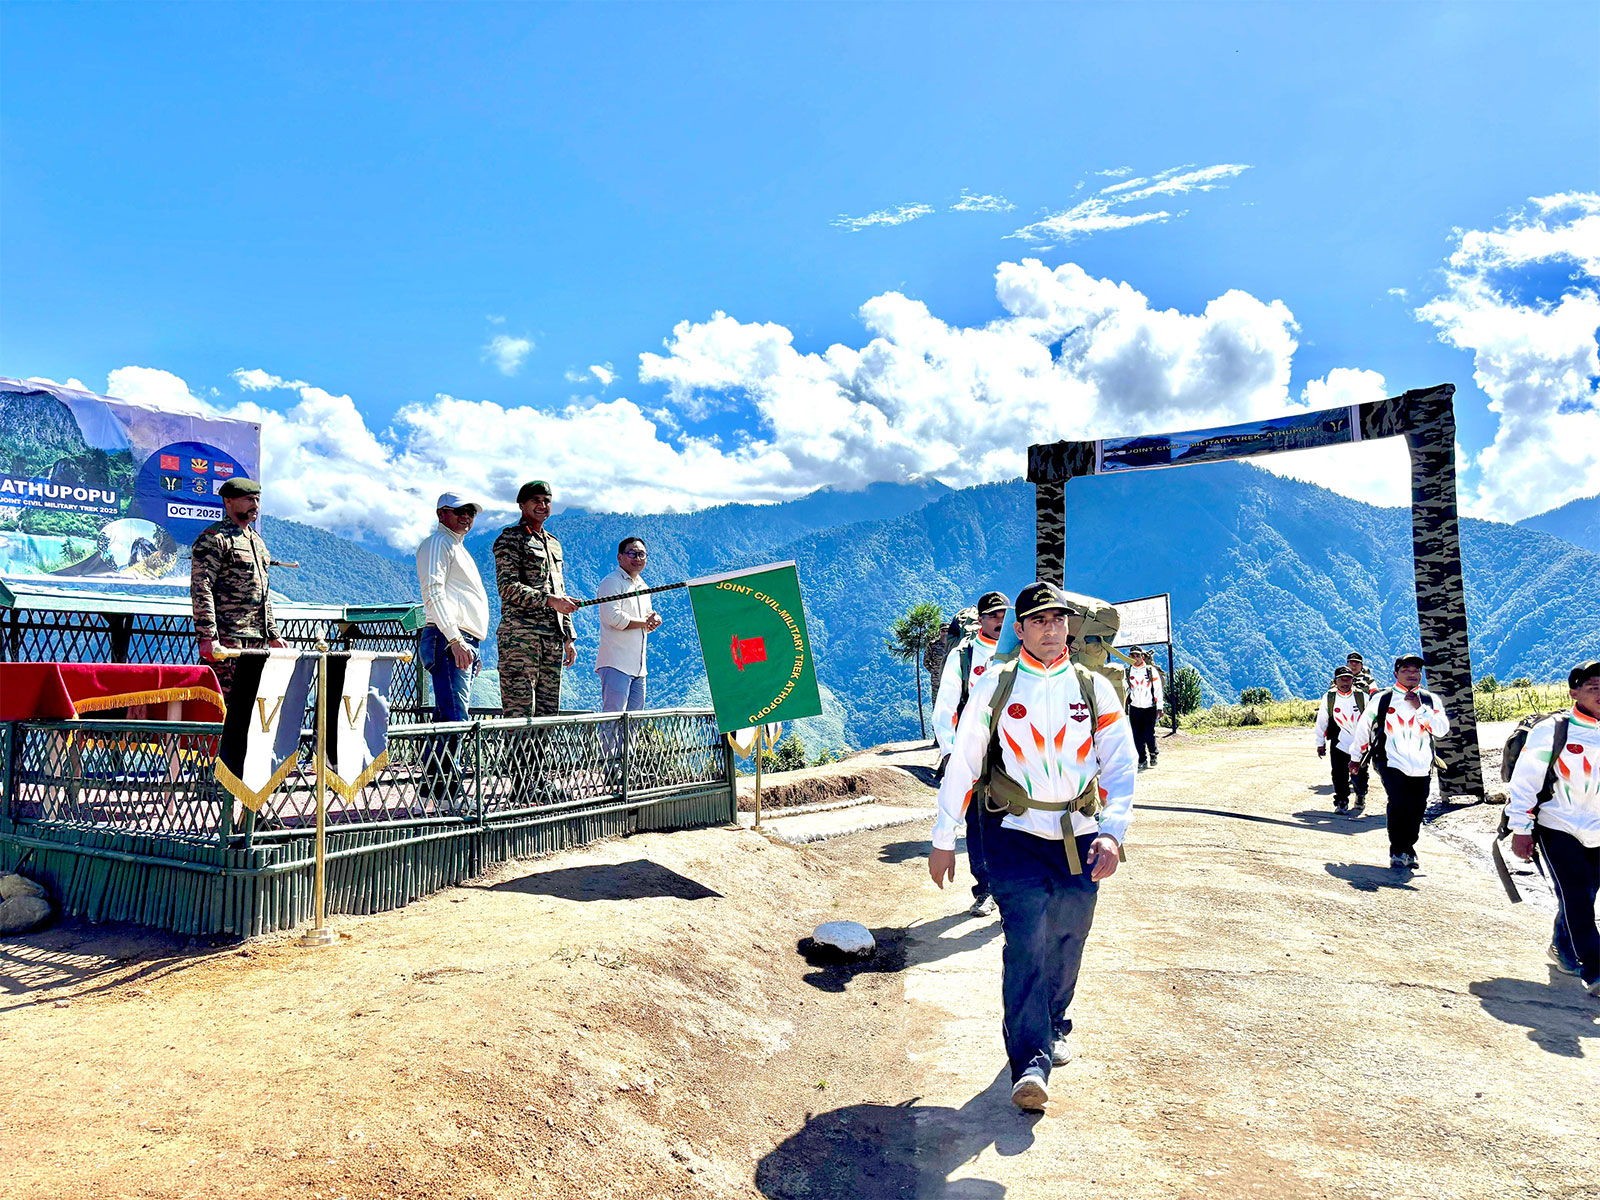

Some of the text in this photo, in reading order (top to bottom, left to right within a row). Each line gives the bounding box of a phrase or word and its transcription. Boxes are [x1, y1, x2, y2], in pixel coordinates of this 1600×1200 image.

[1129, 446, 1154, 454] JOINT
[1156, 443, 1180, 452] CIVIL
[1189, 438, 1232, 449] MILITARY
[1266, 425, 1320, 438] ATHUPOPU
[0, 479, 116, 504] ATHUPOPU
[23, 499, 44, 507] CIVIL
[44, 501, 79, 510] MILITARY
[80, 505, 99, 513] TREK
[100, 506, 118, 515] 2025
[169, 506, 221, 519] OCT 2025
[716, 581, 754, 595] JOINT
[790, 653, 804, 680] TREK
[256, 696, 286, 733] V
[748, 680, 796, 724] ATHOPOPU
